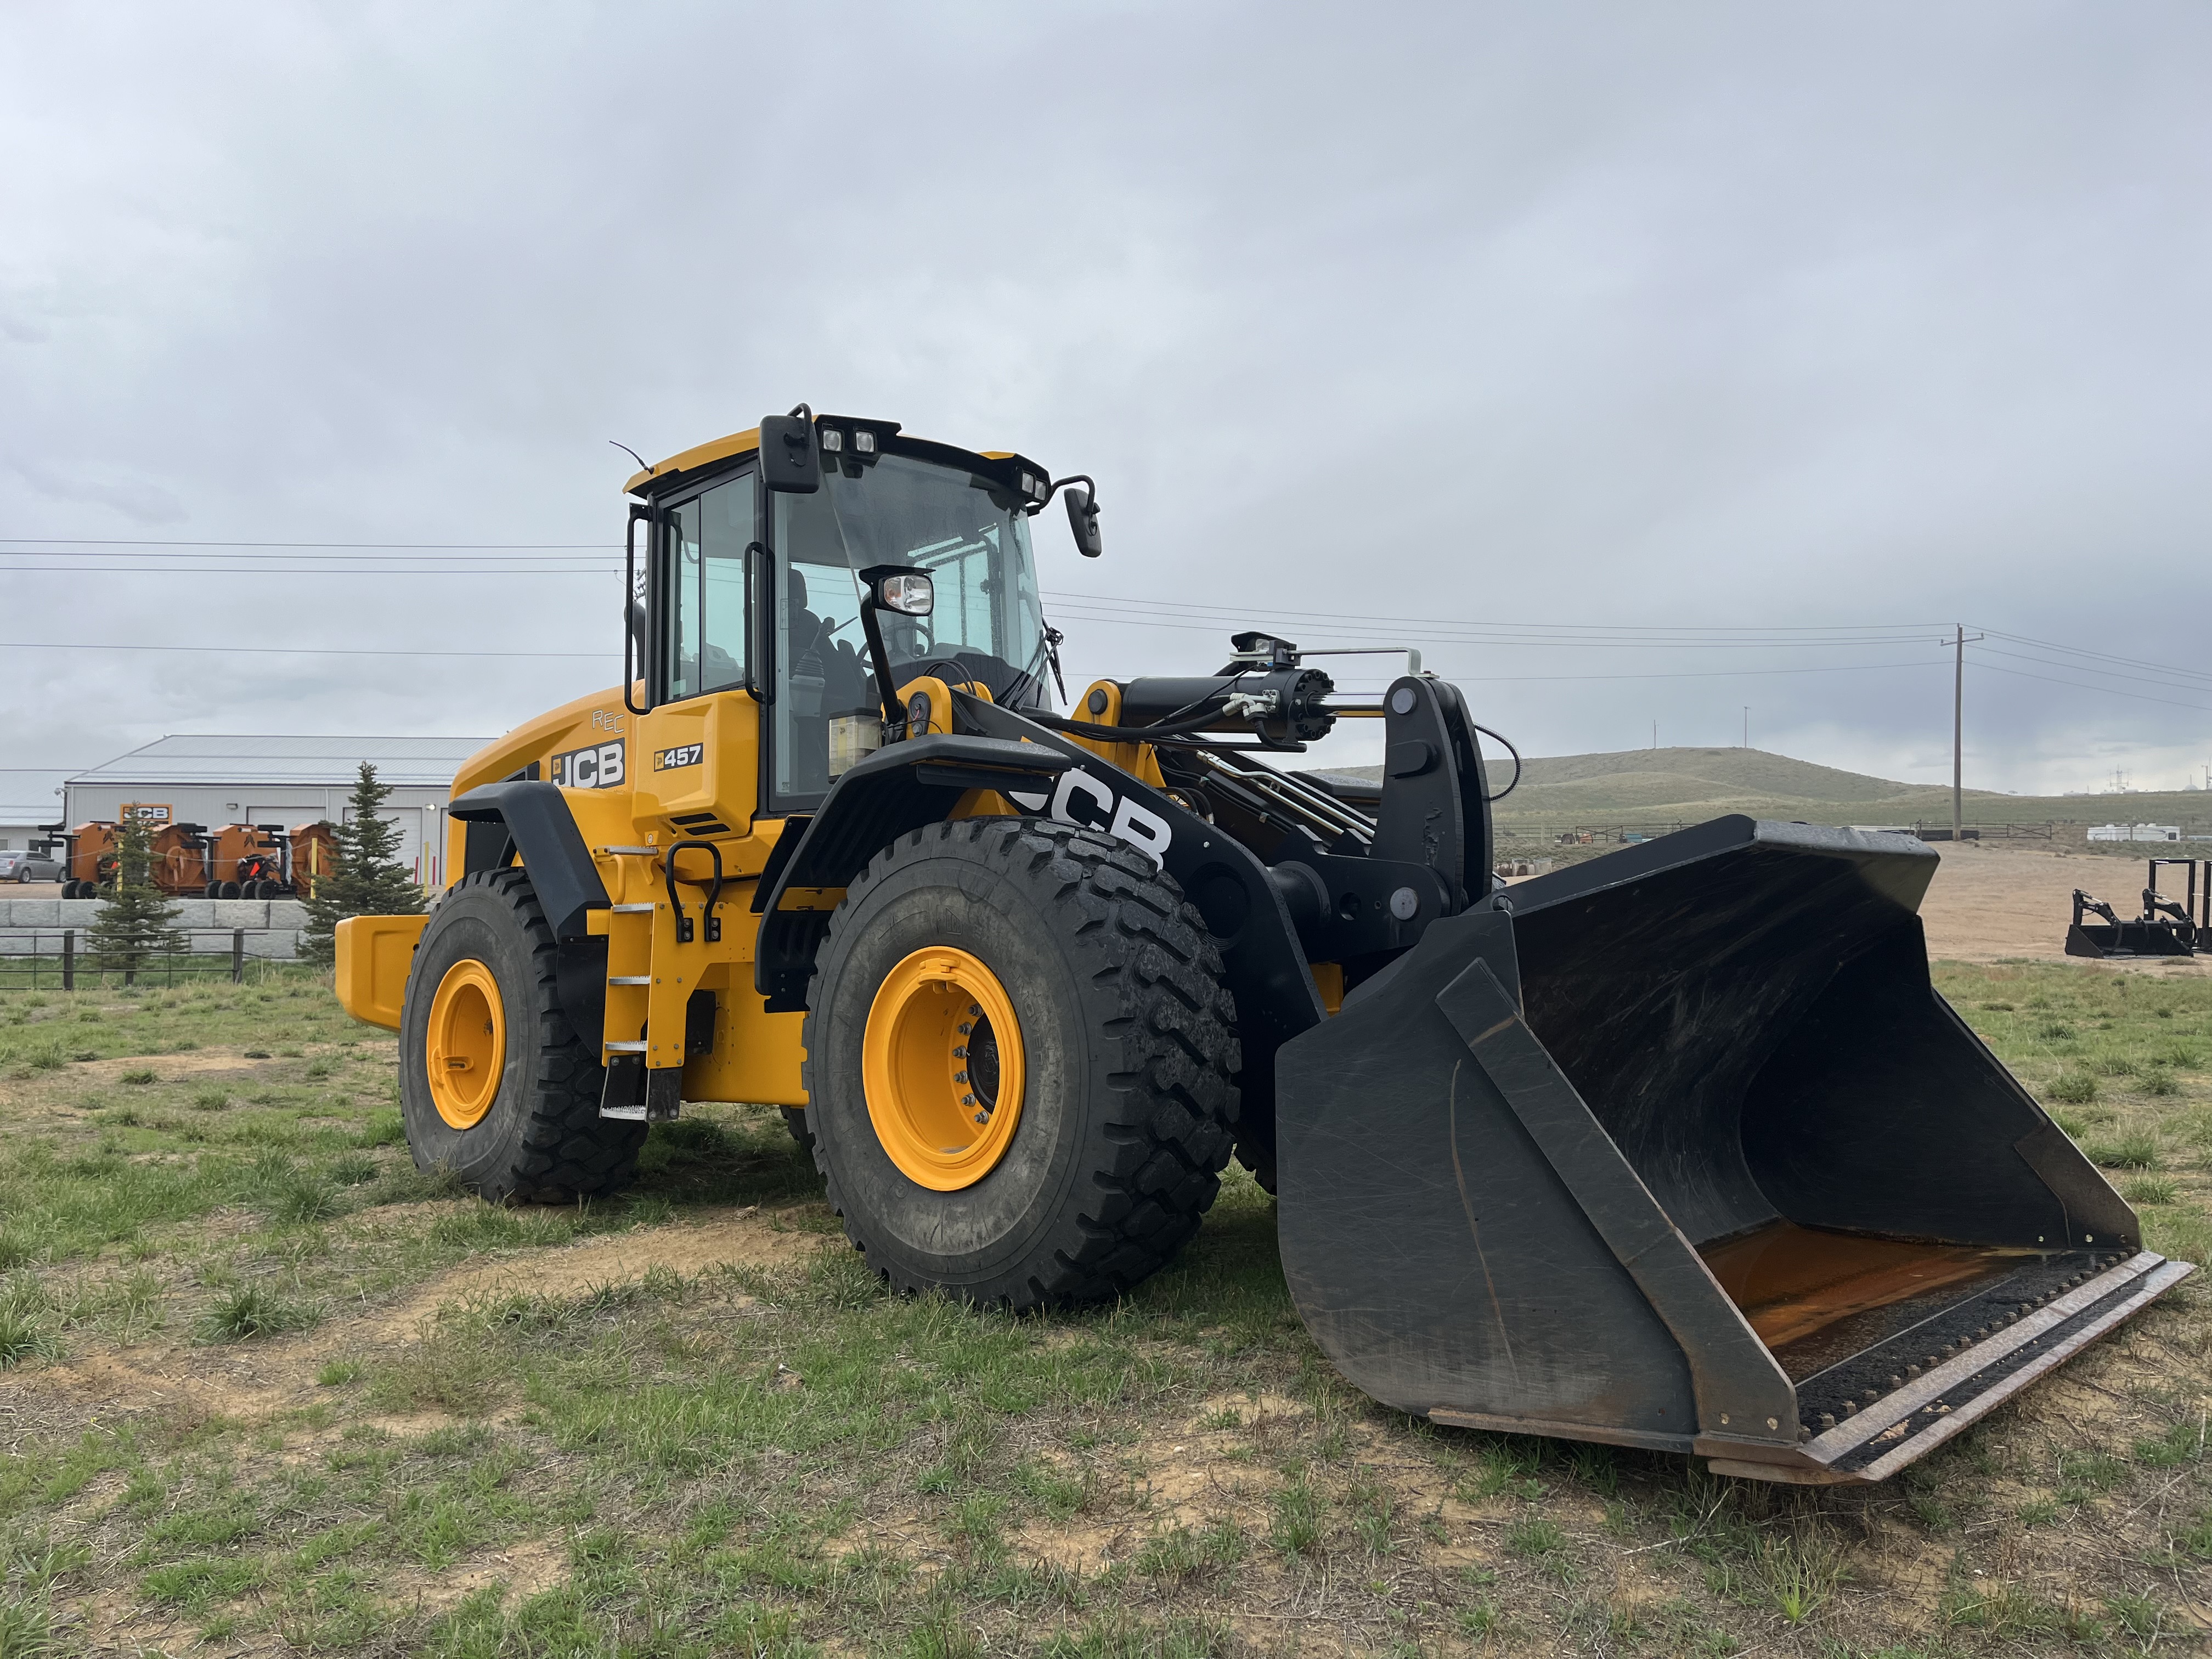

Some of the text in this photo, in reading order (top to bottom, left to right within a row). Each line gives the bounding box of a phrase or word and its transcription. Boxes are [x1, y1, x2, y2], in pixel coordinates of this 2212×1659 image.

[592, 709, 624, 733] REC
[552, 743, 623, 788] JCB
[664, 745, 702, 767] 457
